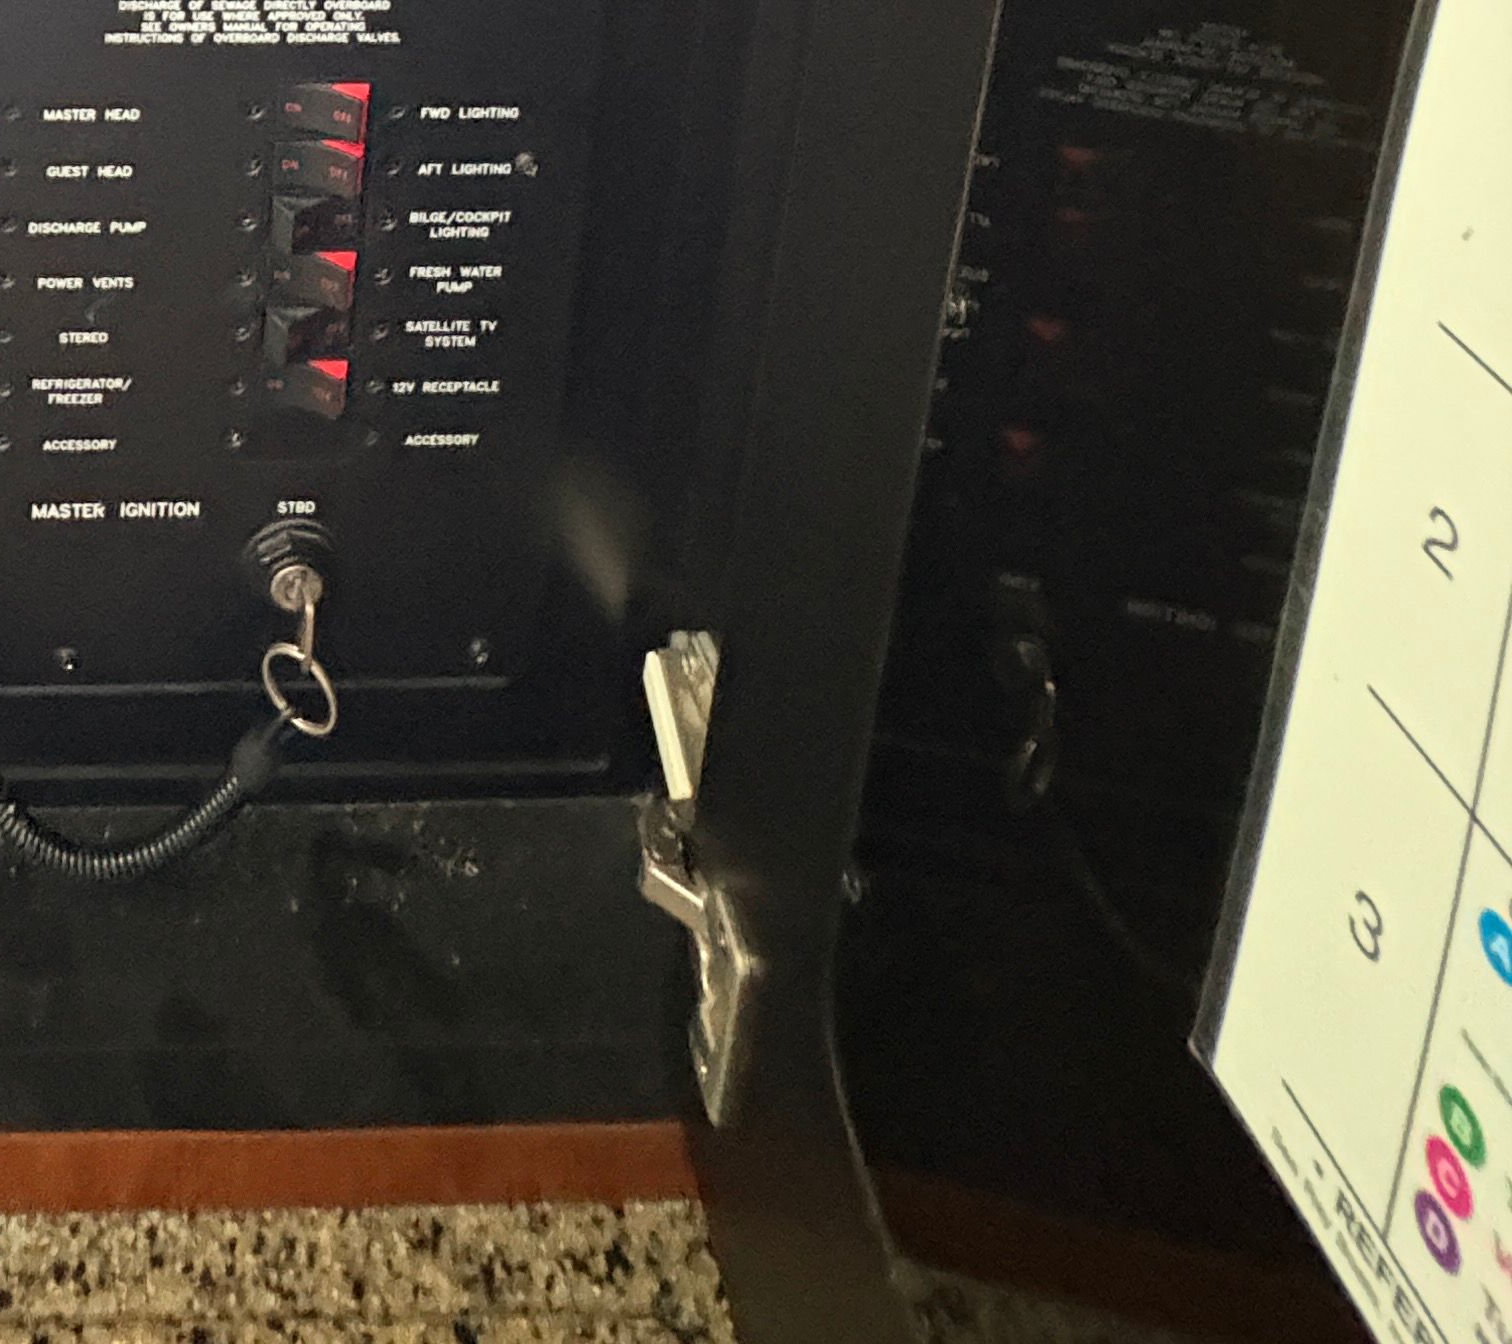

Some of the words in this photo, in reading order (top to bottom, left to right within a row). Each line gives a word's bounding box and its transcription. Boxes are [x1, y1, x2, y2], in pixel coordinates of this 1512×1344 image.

[43, 109, 96, 121] MASTER
[104, 109, 141, 121] HEAD
[420, 107, 450, 119] FWD
[459, 107, 519, 119] LIGHTING
[47, 166, 89, 177] GUEST
[97, 166, 133, 178] HEAD
[418, 164, 442, 175] AFT
[452, 163, 511, 175] LIGHTING
[409, 211, 511, 224] BILGE/COCKPIT
[28, 222, 101, 234] DISCHARGE
[110, 221, 147, 233] PUMP
[430, 227, 489, 238] LIGHTING
[410, 266, 451, 278] FRESH
[460, 266, 502, 278] WATER
[38, 277, 83, 289] POWER
[92, 277, 134, 289] VENTS
[437, 282, 473, 293] PUMP
[406, 321, 470, 332] SATELLITE
[480, 320, 497, 332] TV
[59, 332, 109, 344] STEREO
[425, 336, 476, 347] SYSTEM
[32, 378, 132, 392] REFRIGERATOR/
[393, 382, 414, 393] 12V
[422, 381, 499, 392] RECEPTACLE
[48, 394, 103, 404] FREEZER
[43, 440, 117, 451] ACCESSORY
[404, 434, 479, 446] ACCESSORY
[32, 503, 105, 519] MASTER
[120, 502, 200, 518] IGNITION
[277, 501, 316, 514] STBD
[1423, 506, 1459, 581] 2
[1349, 891, 1383, 963] 3
